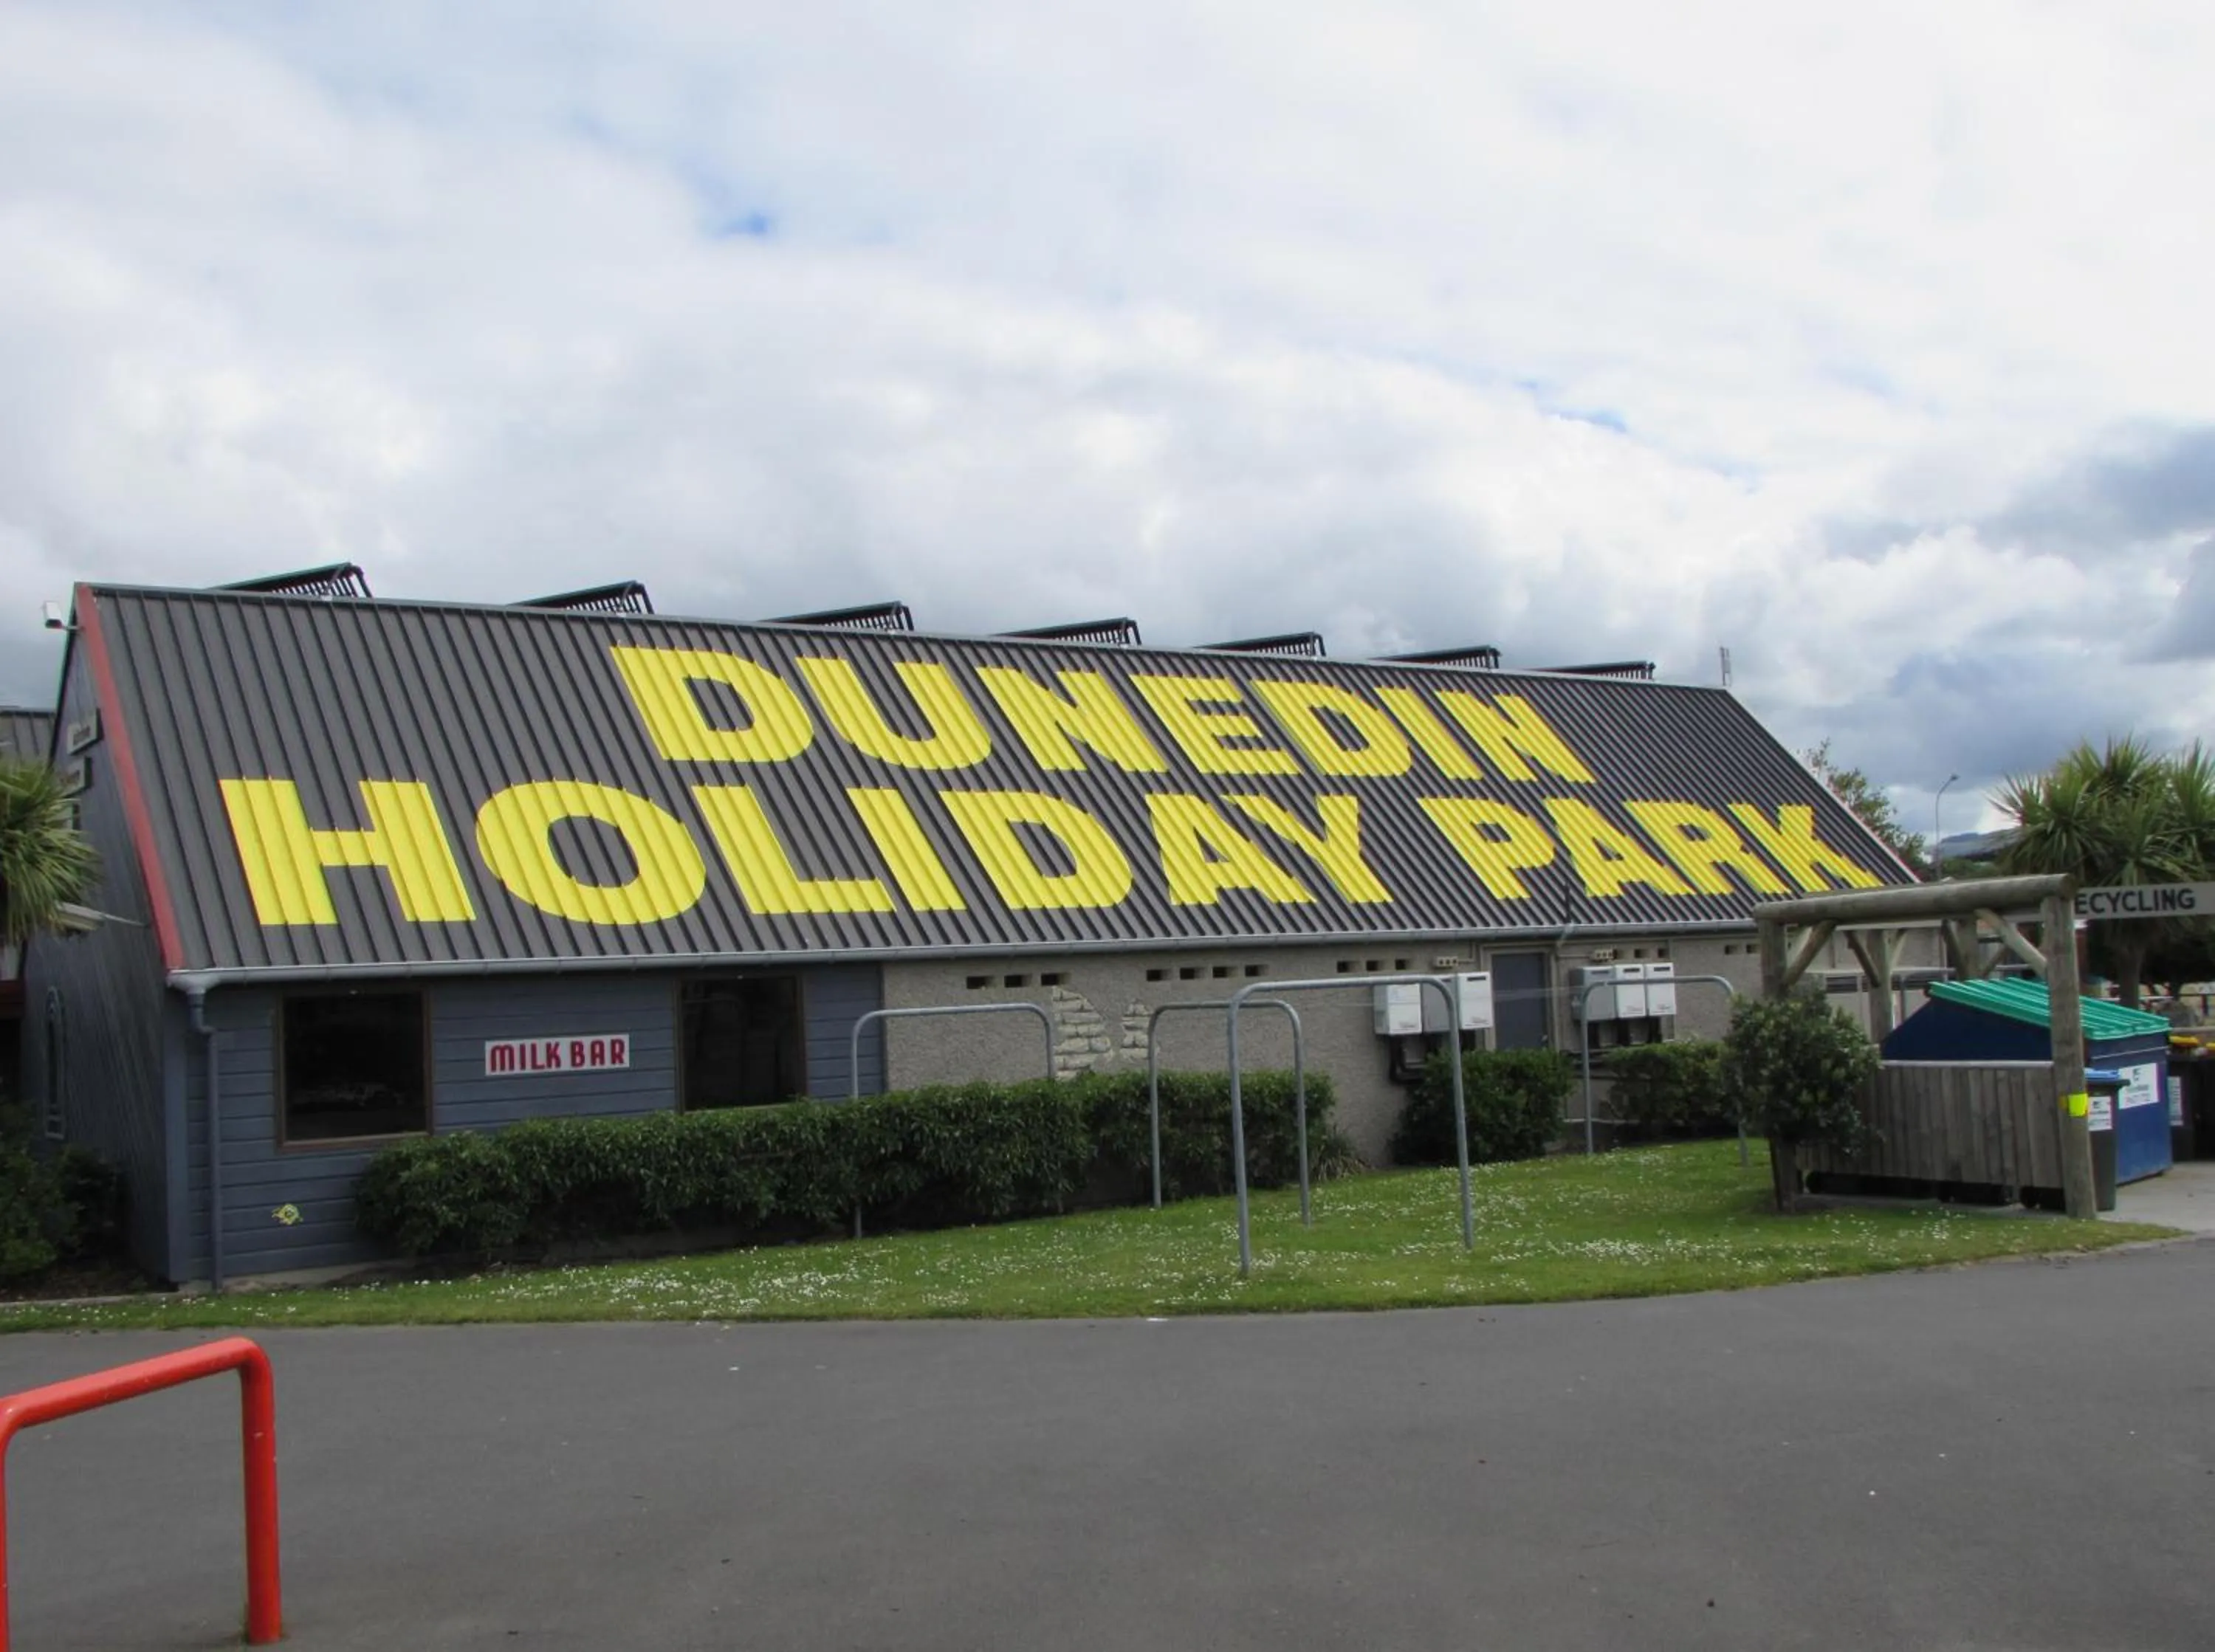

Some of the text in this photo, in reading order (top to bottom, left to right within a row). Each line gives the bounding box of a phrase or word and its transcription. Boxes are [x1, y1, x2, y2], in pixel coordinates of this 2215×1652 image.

[612, 645, 1594, 783] DUNEDIN
[220, 778, 1881, 925] HOLIDAY PARK
[2074, 888, 2196, 915] ECYCLING
[490, 1039, 625, 1072] MILK BAR
